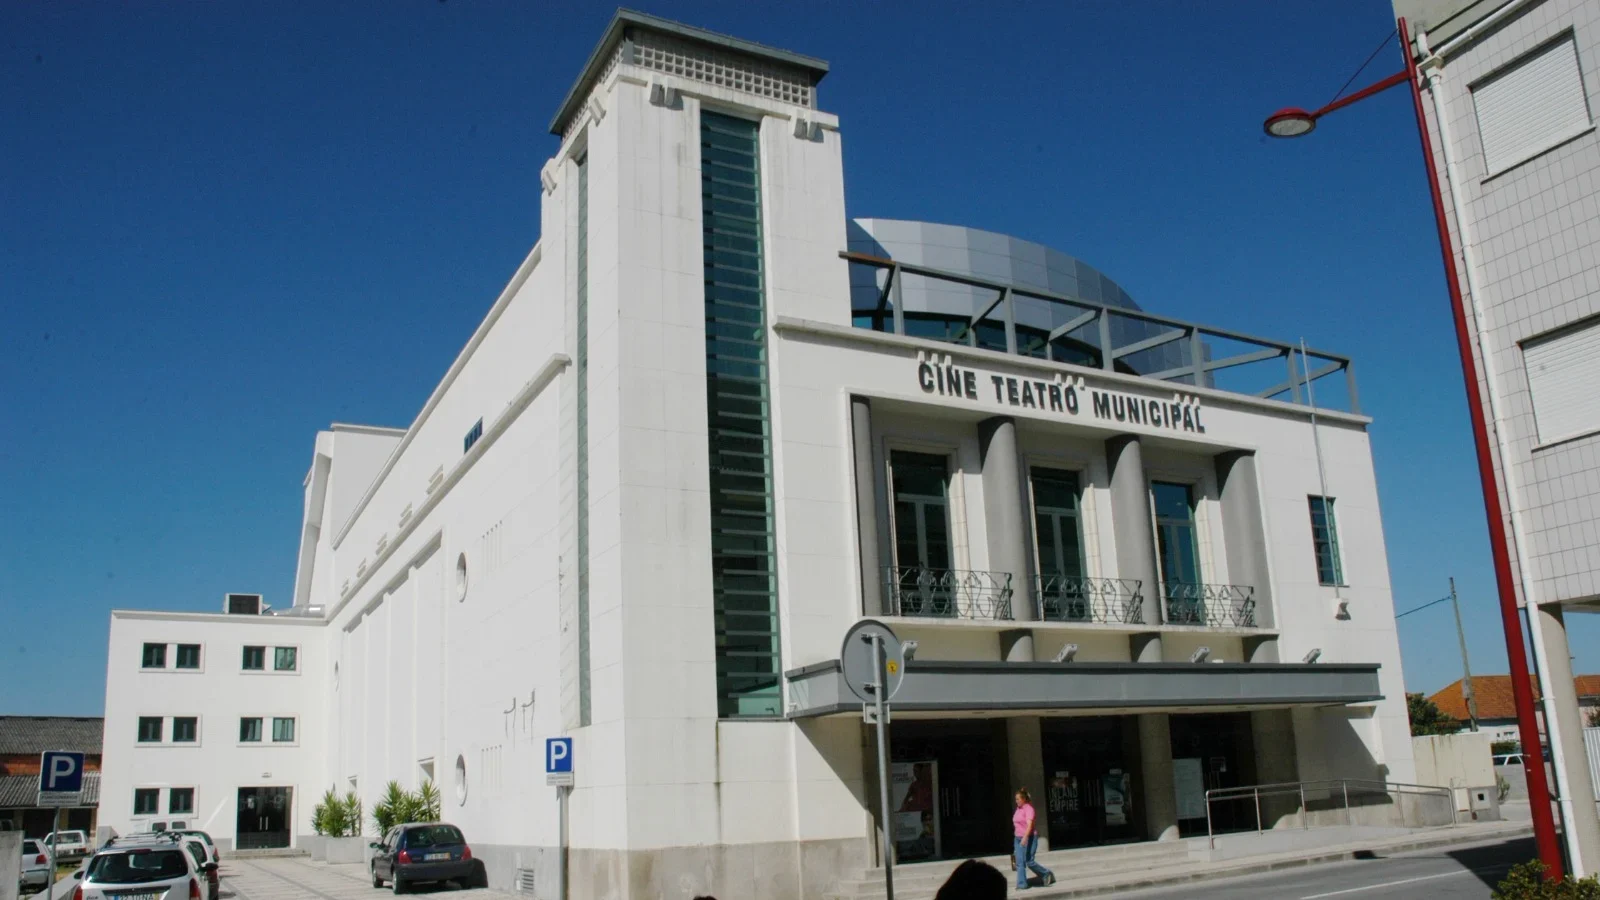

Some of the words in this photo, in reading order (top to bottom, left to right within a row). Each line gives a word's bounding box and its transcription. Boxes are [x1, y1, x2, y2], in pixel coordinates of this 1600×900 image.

[918, 363, 977, 400] CINE
[991, 375, 1079, 415] TEATRO
[1093, 391, 1205, 433] MUNICIPAL
[551, 741, 568, 770] P
[49, 756, 75, 788] P
[1049, 788, 1079, 800] INLAND
[1050, 799, 1079, 812] EMPIRE
